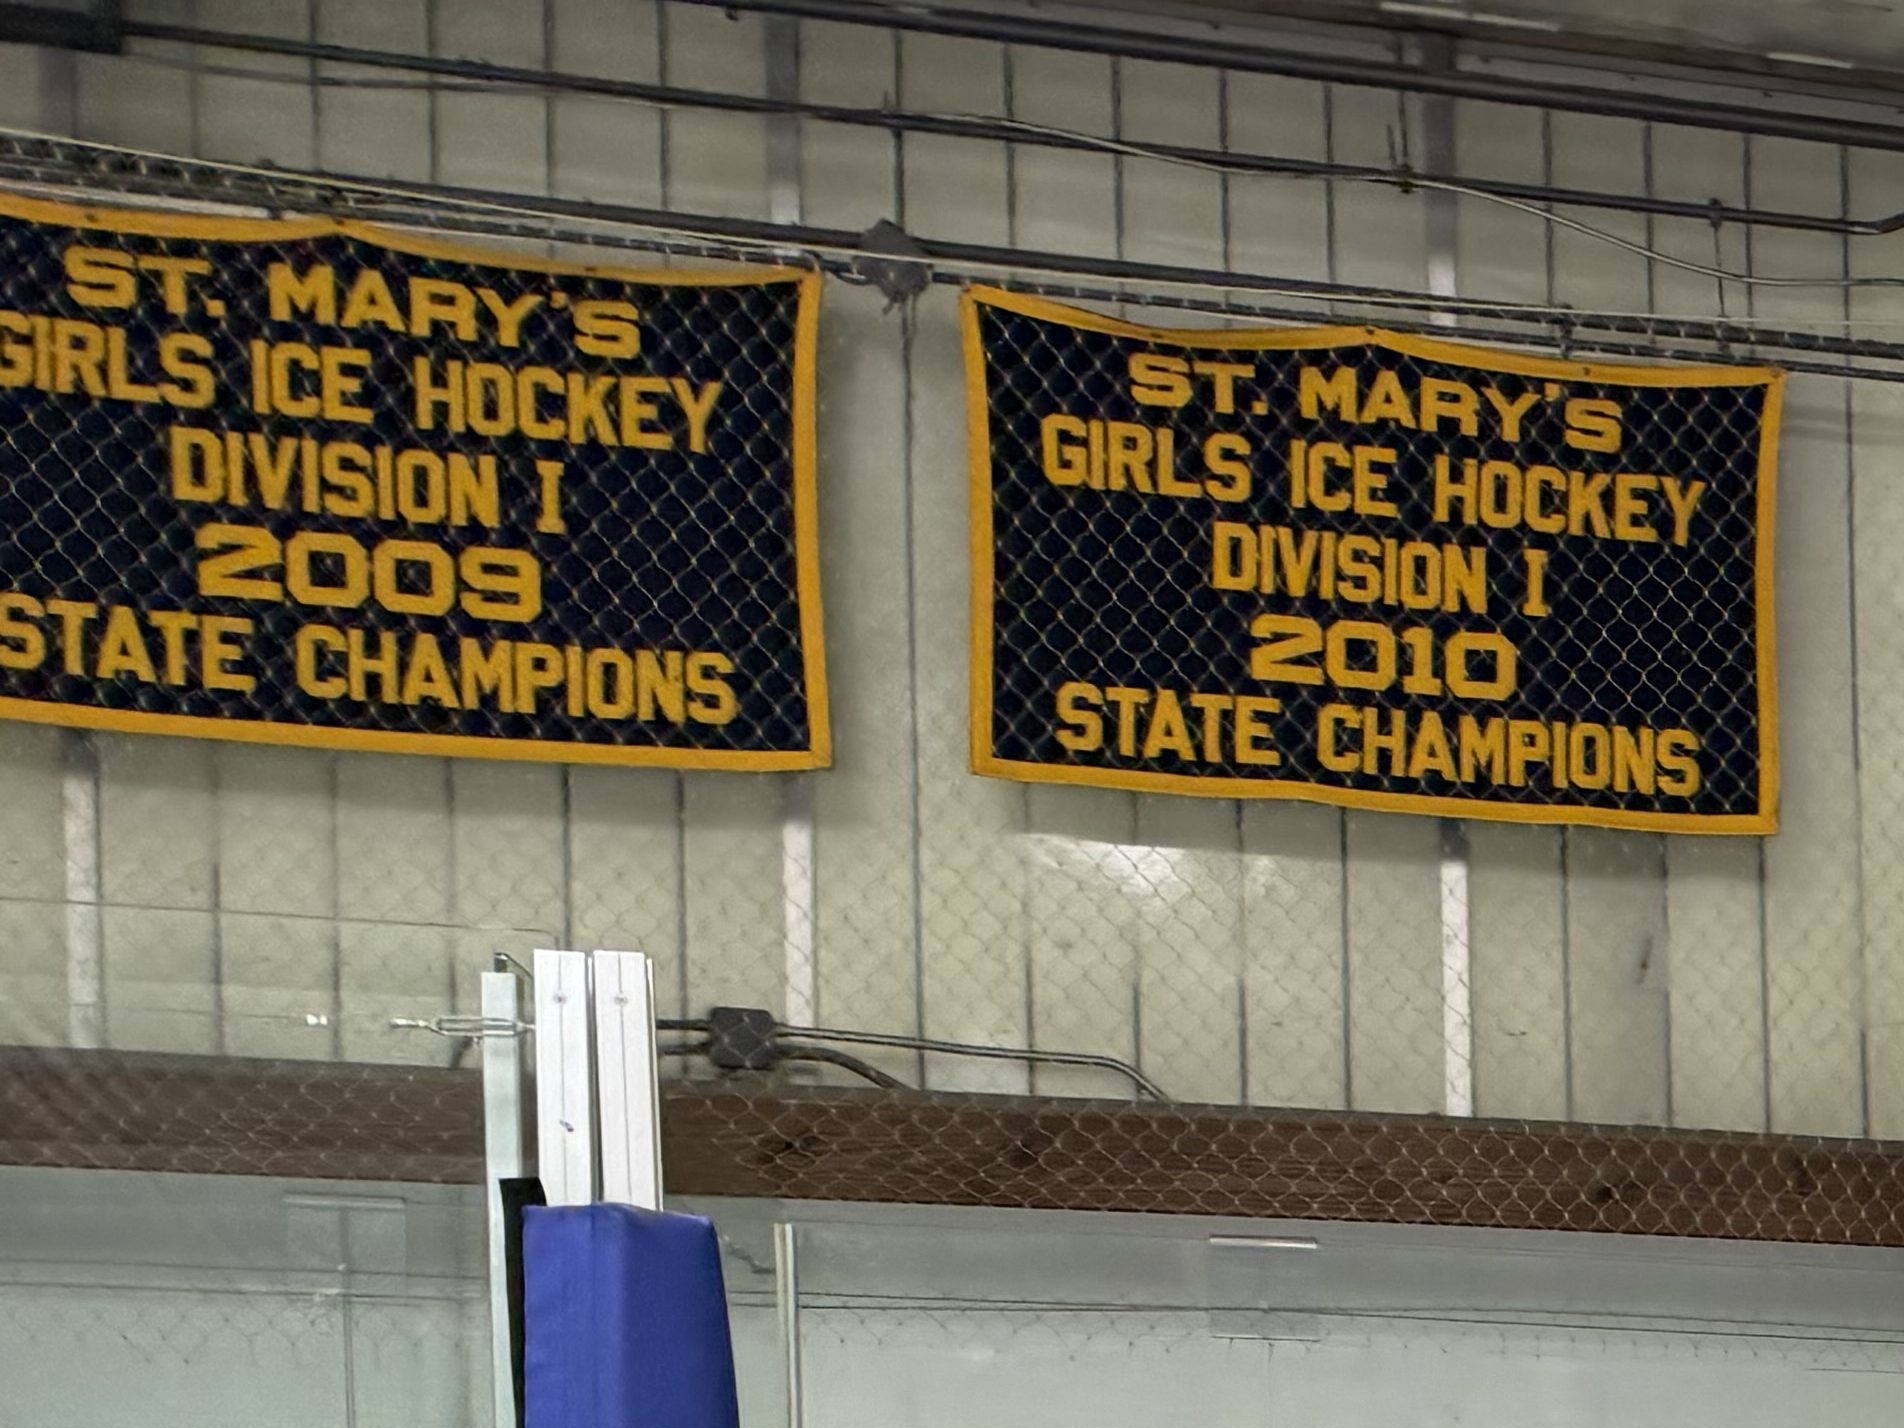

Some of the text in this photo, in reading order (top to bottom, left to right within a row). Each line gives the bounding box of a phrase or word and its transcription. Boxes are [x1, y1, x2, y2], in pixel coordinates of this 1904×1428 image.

[65, 247, 641, 359] ST. MARY'S
[252, 339, 374, 425] ICE
[416, 359, 723, 454] HOCKEY
[1129, 353, 1623, 454] ST. MARY'S
[171, 426, 500, 528] DIVISION
[1040, 415, 1705, 547] GIRLS ICE HOCKEY
[199, 524, 542, 624] 2009
[1212, 522, 1486, 614] DIVISION
[0, 593, 740, 727] STATE CHAMPIONS
[1249, 614, 1517, 701] 2010
[1055, 682, 1702, 797] STATE CHAMPIONS
